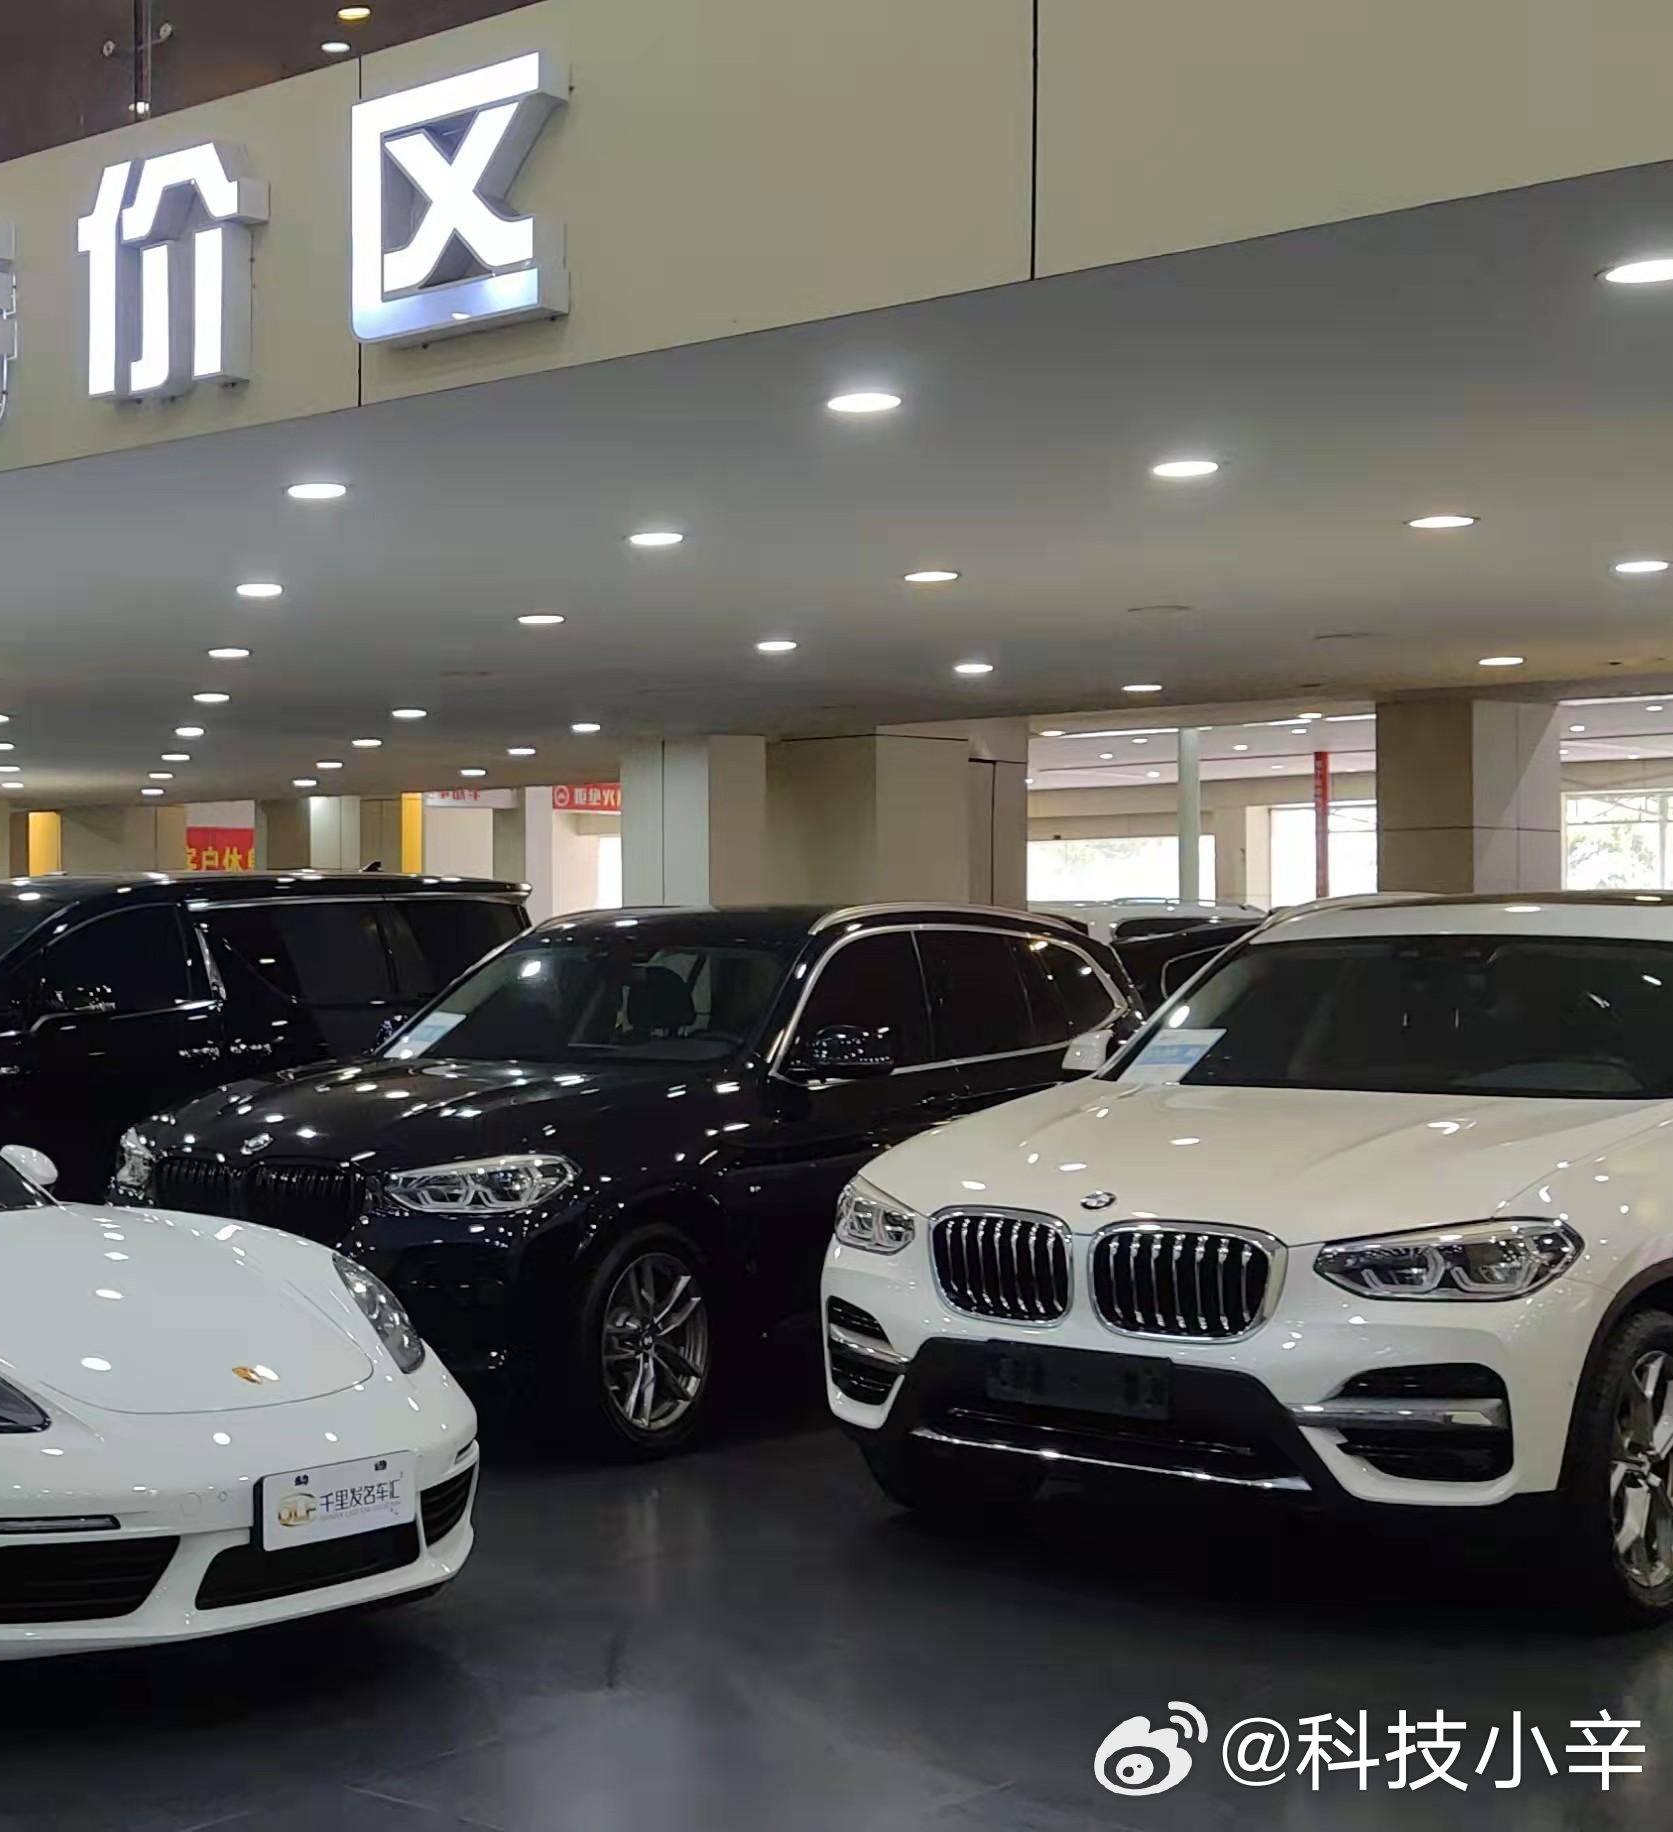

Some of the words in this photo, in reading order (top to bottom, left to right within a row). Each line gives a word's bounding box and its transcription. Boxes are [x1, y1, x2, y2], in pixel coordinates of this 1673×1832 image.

[319, 1478, 401, 1513] 千里发名车汇
